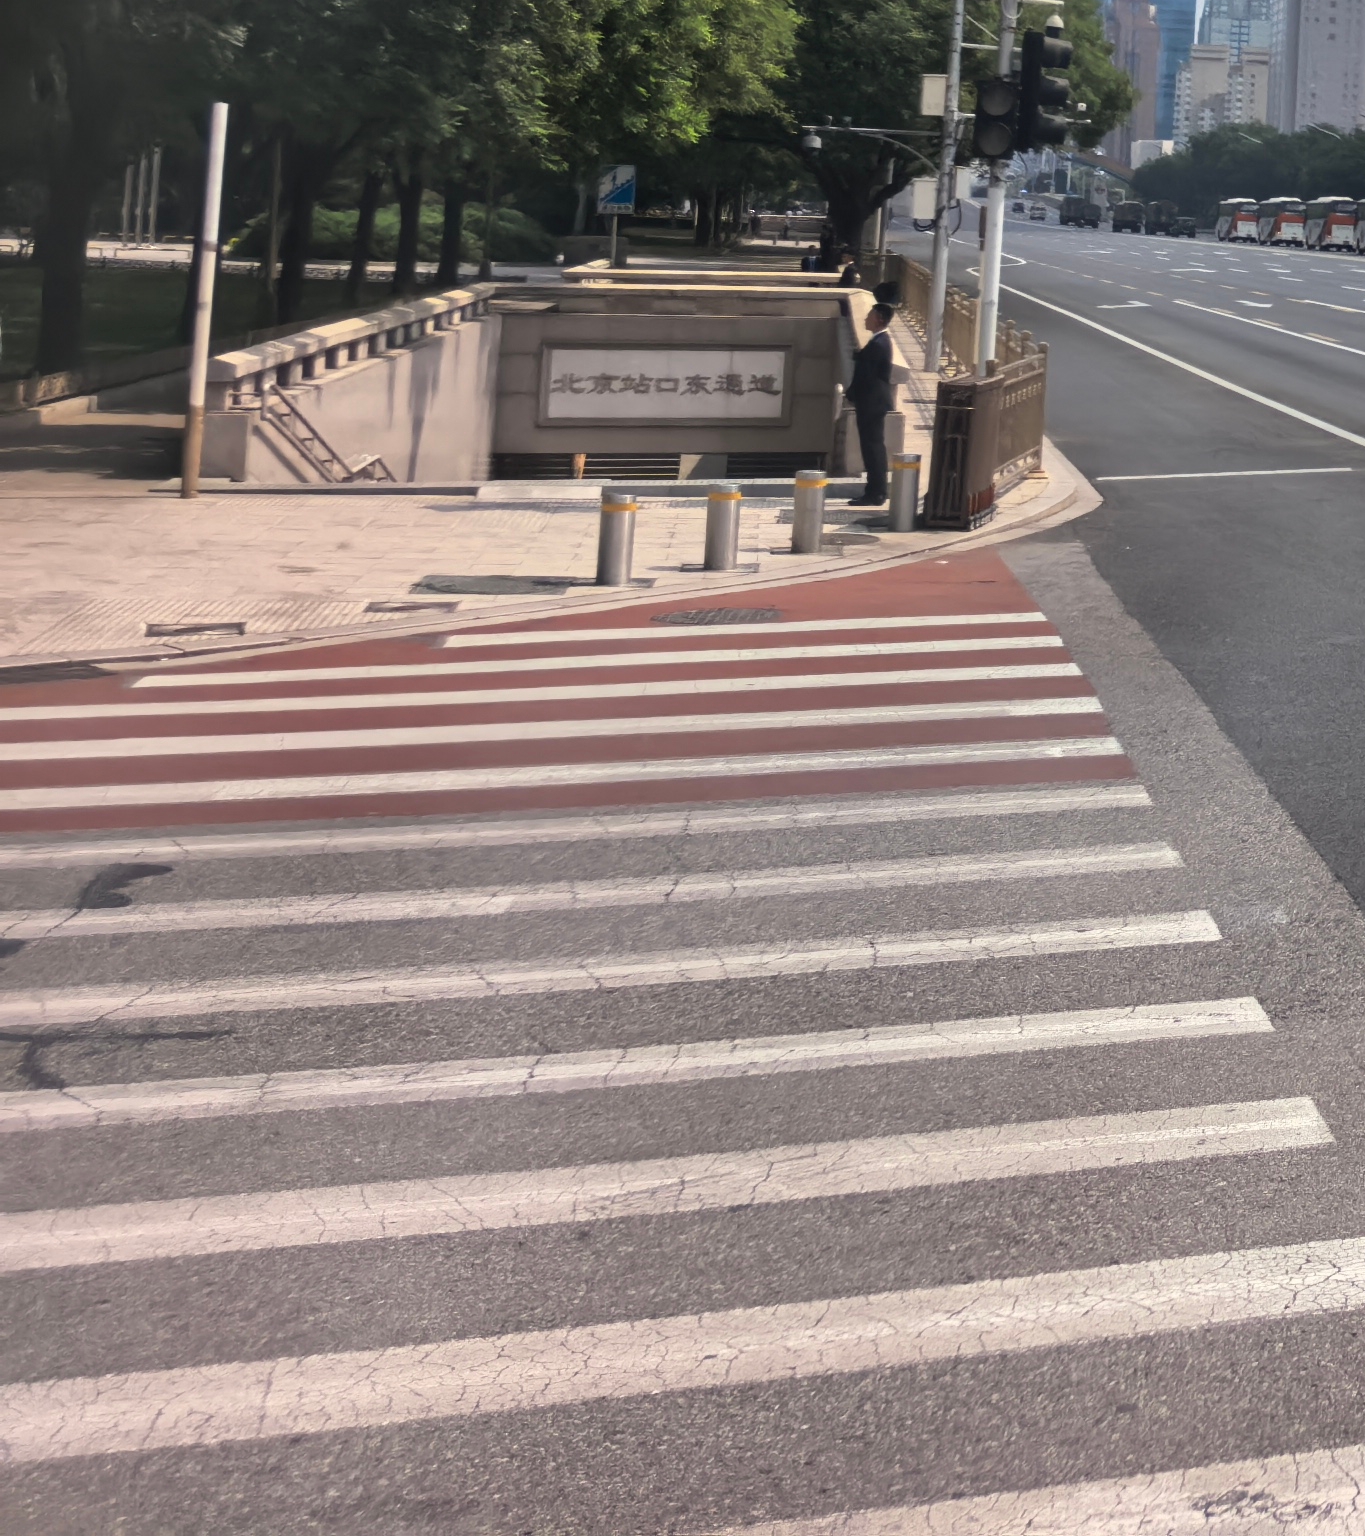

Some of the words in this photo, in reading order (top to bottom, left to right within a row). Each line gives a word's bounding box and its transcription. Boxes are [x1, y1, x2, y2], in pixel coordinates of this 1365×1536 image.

[551, 373, 781, 395] 北京站口东通道
